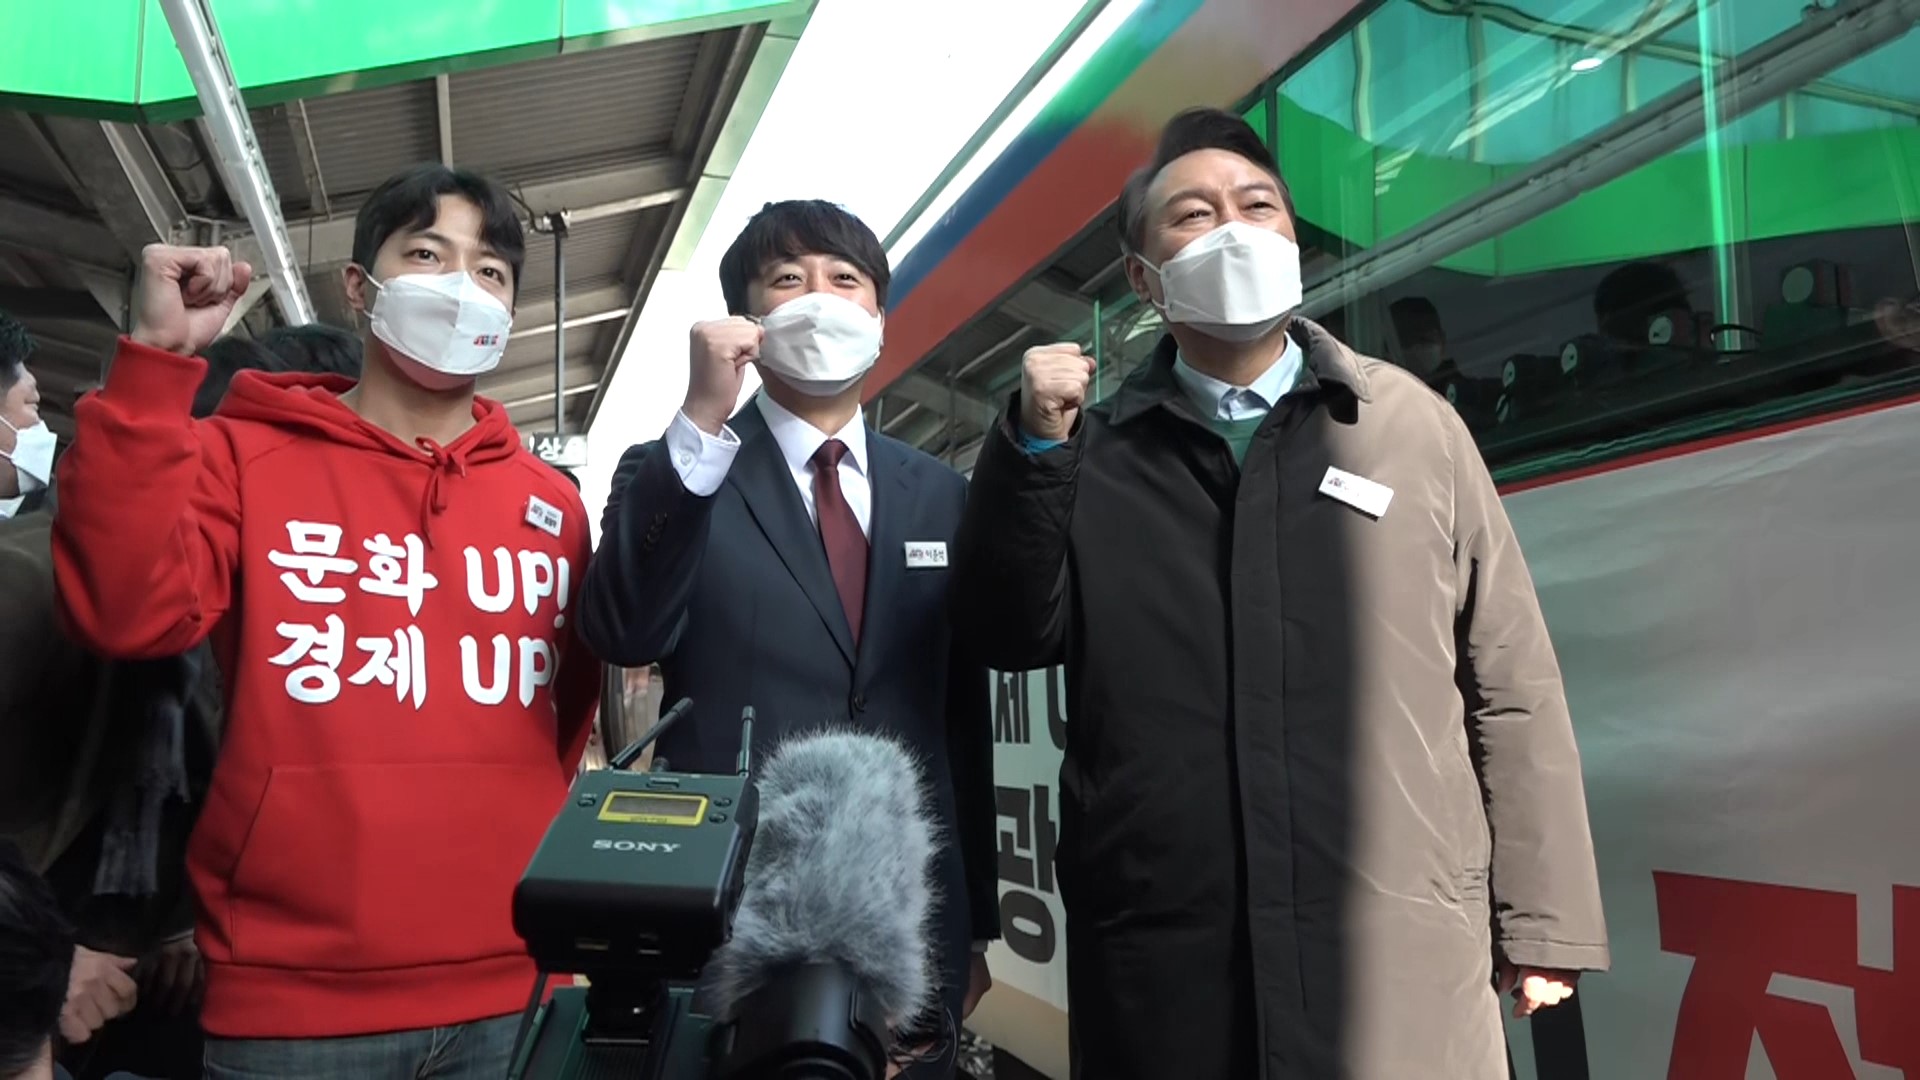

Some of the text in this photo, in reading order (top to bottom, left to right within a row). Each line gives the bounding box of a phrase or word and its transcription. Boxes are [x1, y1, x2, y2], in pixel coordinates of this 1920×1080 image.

[267, 519, 570, 629] 문화 UP!
[267, 613, 428, 711] 경제
[592, 839, 681, 853] SONY
